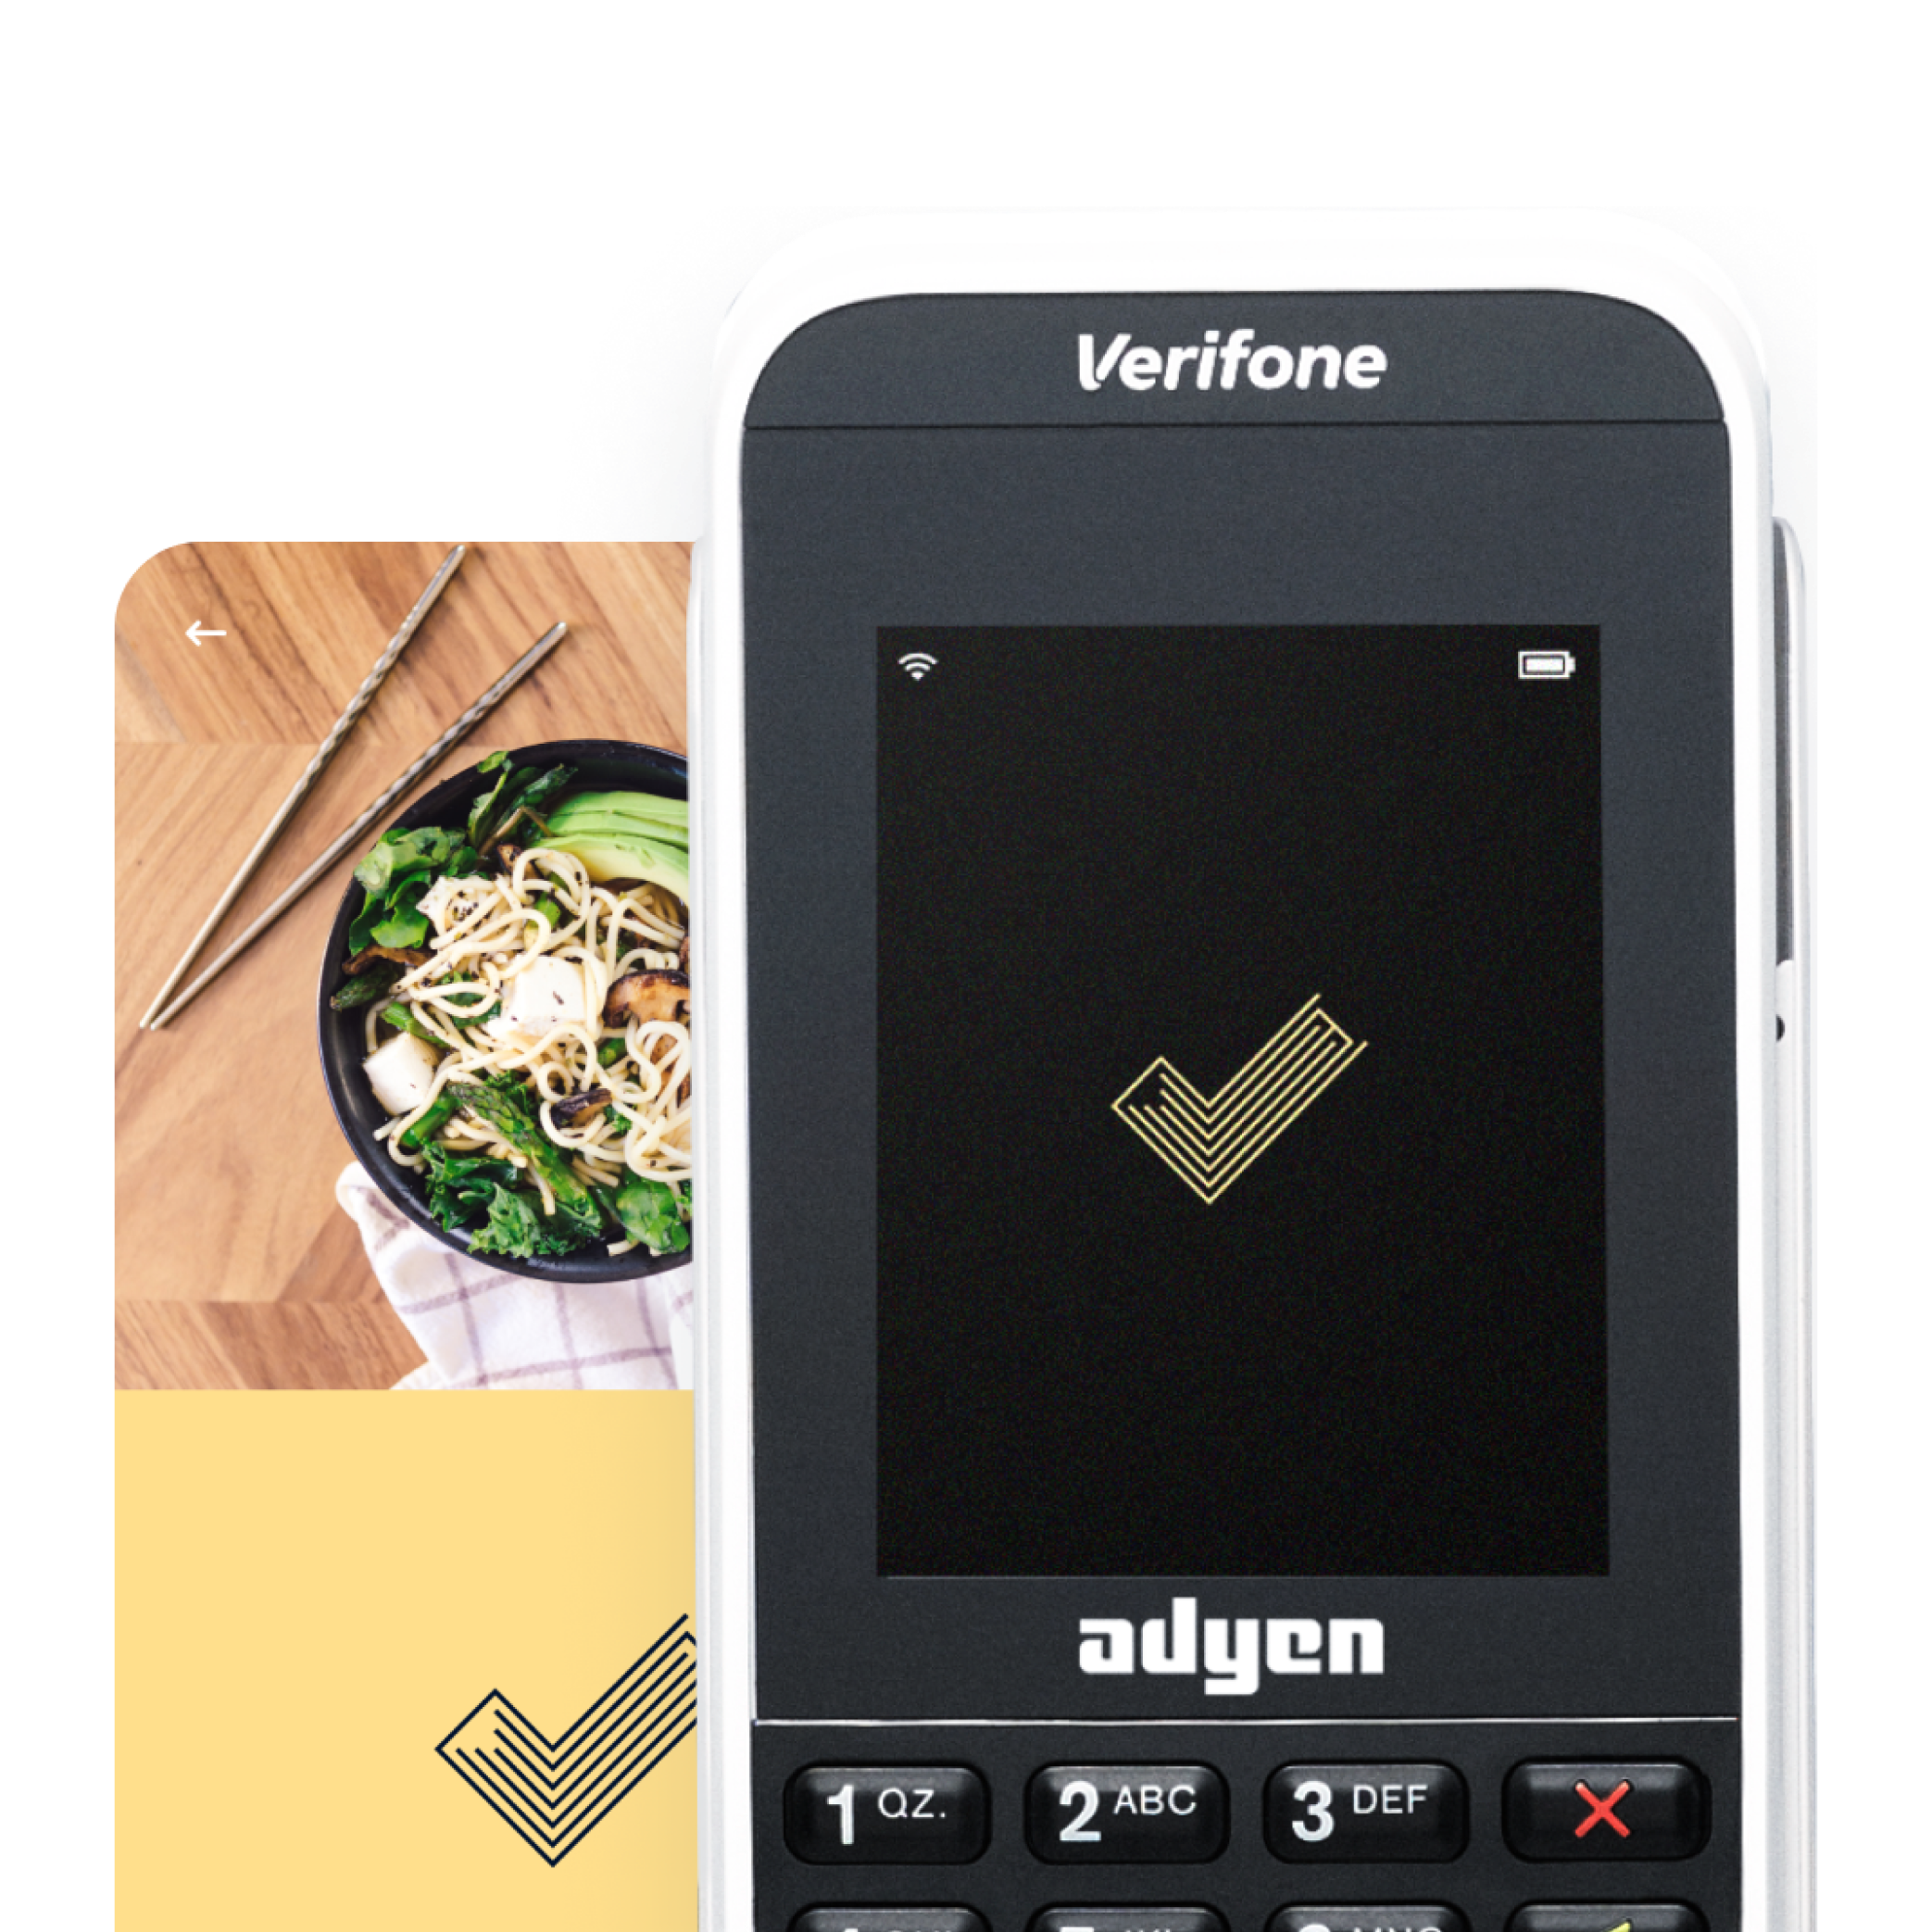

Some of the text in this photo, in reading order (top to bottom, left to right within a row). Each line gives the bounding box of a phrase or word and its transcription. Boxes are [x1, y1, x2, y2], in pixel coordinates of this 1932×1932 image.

[1078, 329, 1387, 391] Verifone
[1079, 1597, 1385, 1695] adyen
[827, 1785, 854, 1844] 1
[1059, 1780, 1198, 1841] 2 ABC
[1292, 1780, 1428, 1841] 3 DEF
